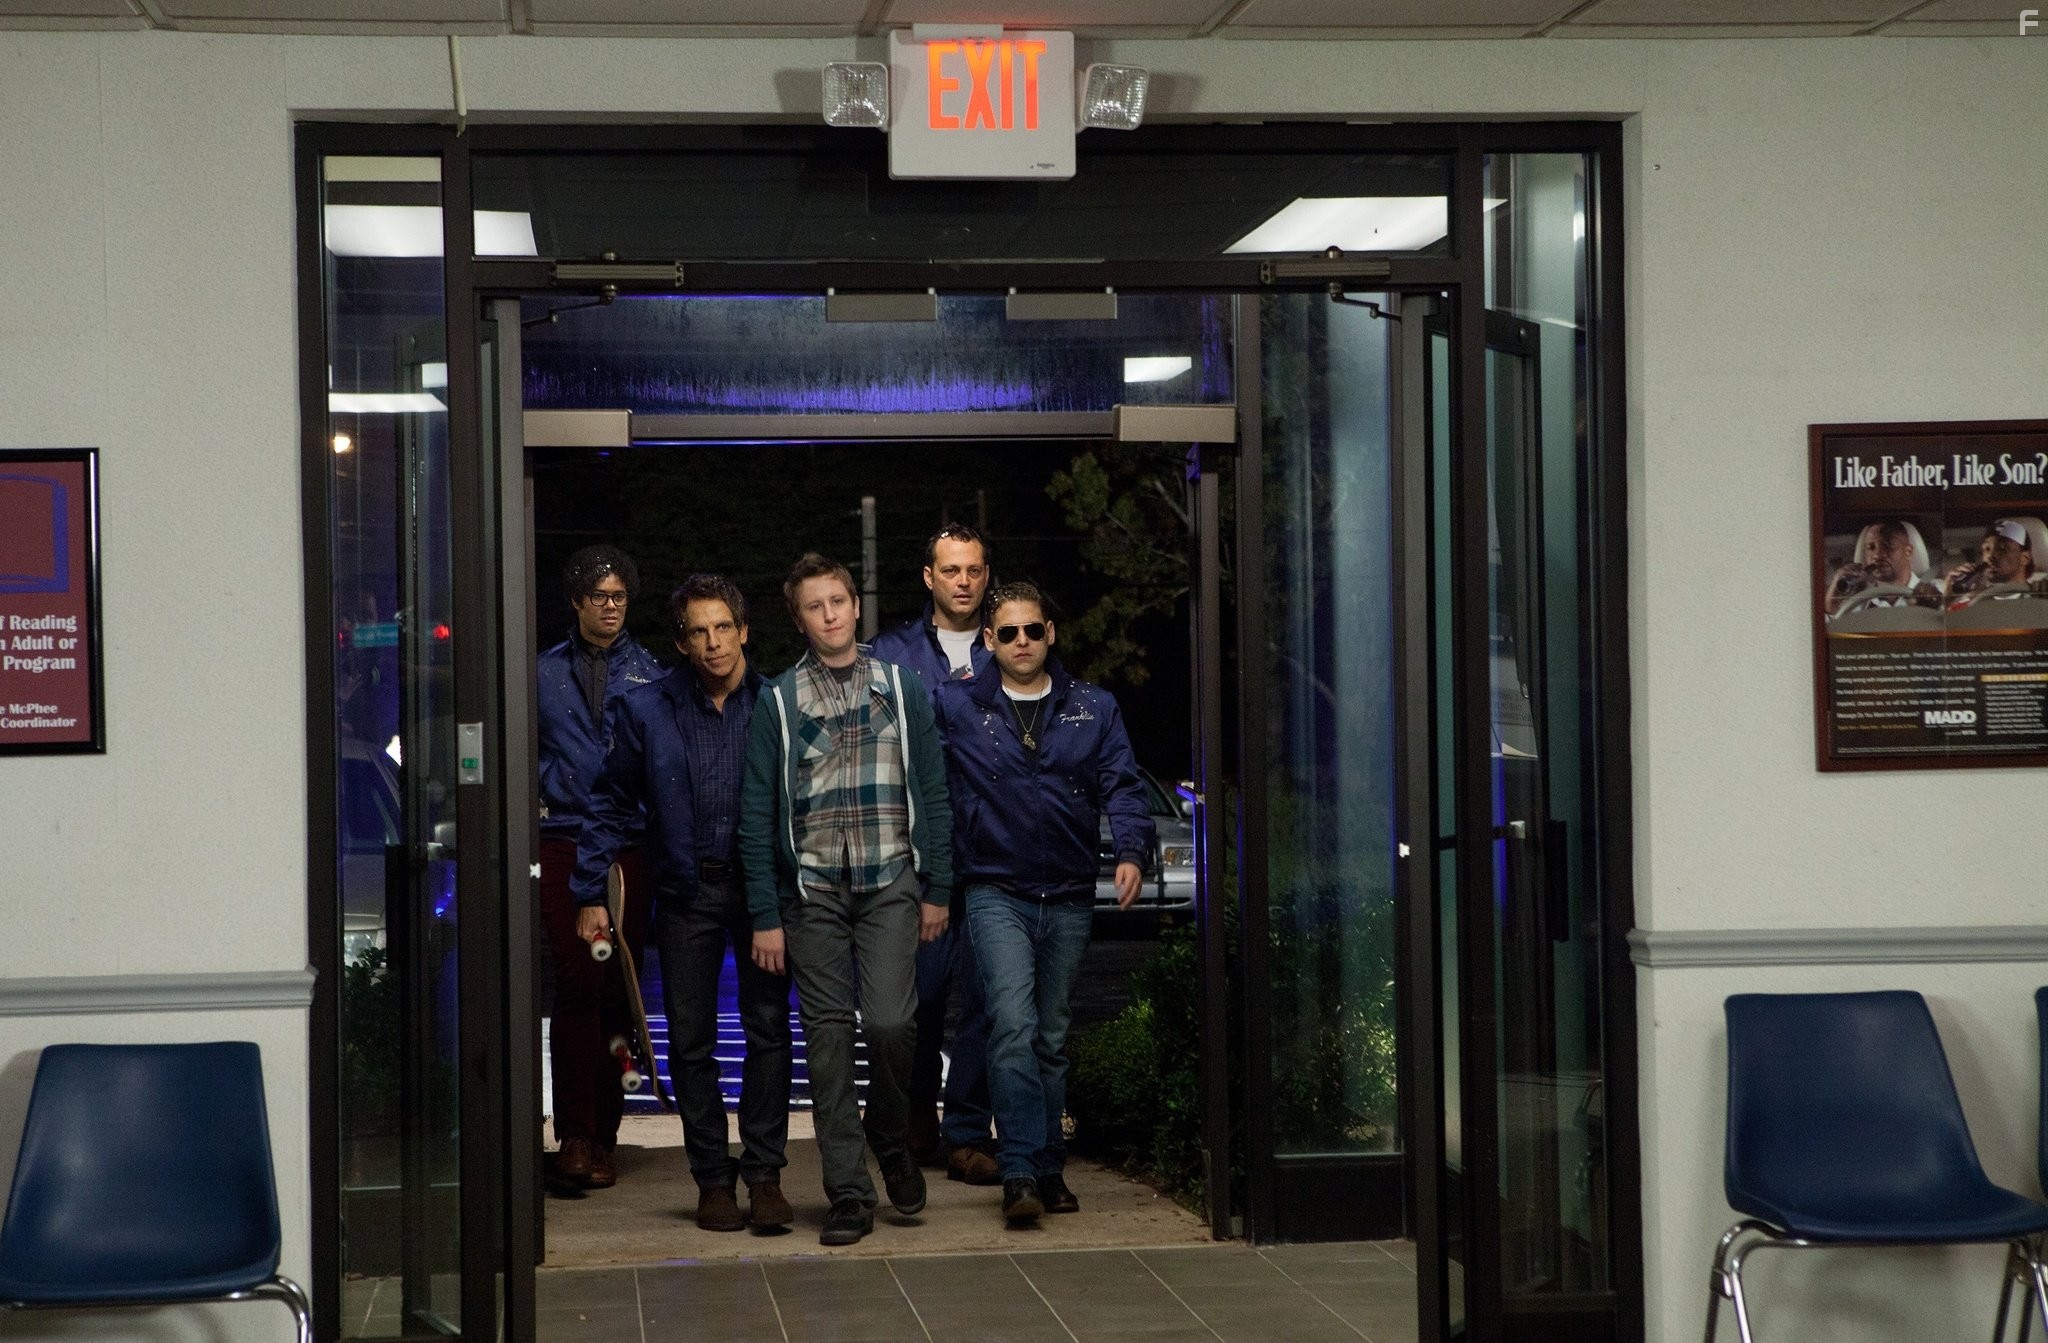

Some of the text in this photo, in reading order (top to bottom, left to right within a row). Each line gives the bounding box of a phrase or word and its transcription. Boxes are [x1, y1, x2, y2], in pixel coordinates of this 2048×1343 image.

[928, 40, 1047, 130] EXIT
[1834, 452, 2048, 490] Like Father, Like Son?
[9, 614, 78, 633] Reading
[11, 635, 54, 650] Adult
[58, 638, 78, 650] or
[3, 655, 76, 674] Program
[9, 703, 58, 714] McPhee
[0, 716, 77, 728] Coordinator
[1924, 710, 1977, 725] MADD
